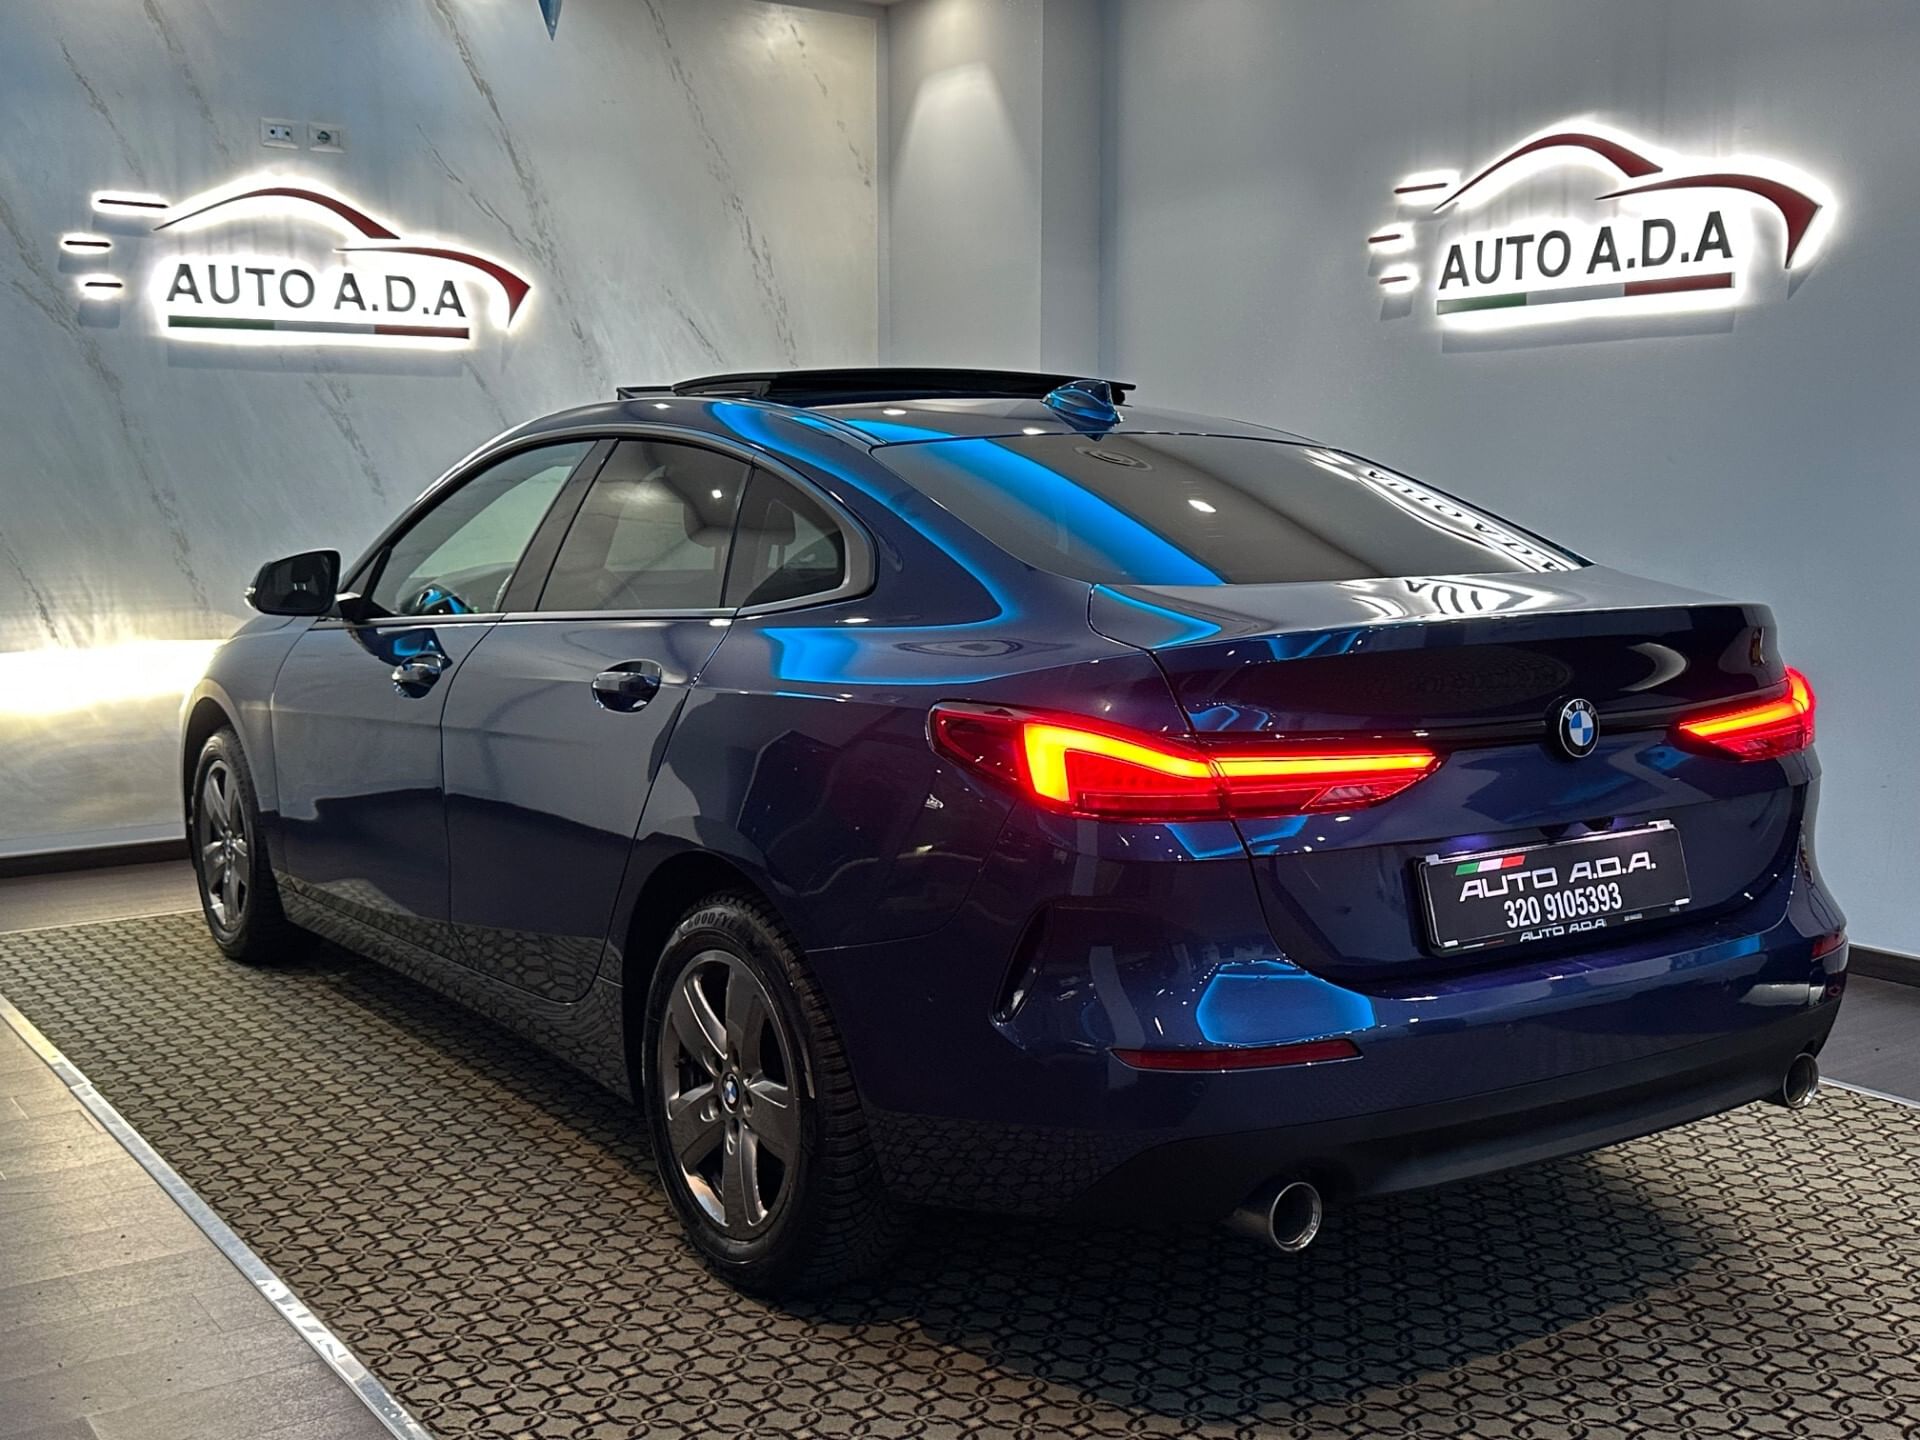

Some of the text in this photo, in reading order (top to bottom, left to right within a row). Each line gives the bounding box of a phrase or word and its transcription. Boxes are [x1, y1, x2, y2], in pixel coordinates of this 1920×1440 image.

[1438, 210, 1734, 291] AUTO A.D.A
[166, 263, 467, 318] AUTO A.D.A
[1564, 701, 1596, 720] BMW
[1459, 851, 1657, 902] AUTO A.D.A.
[1503, 882, 1623, 929] 320 9105393
[1520, 926, 1565, 943] AUTO
